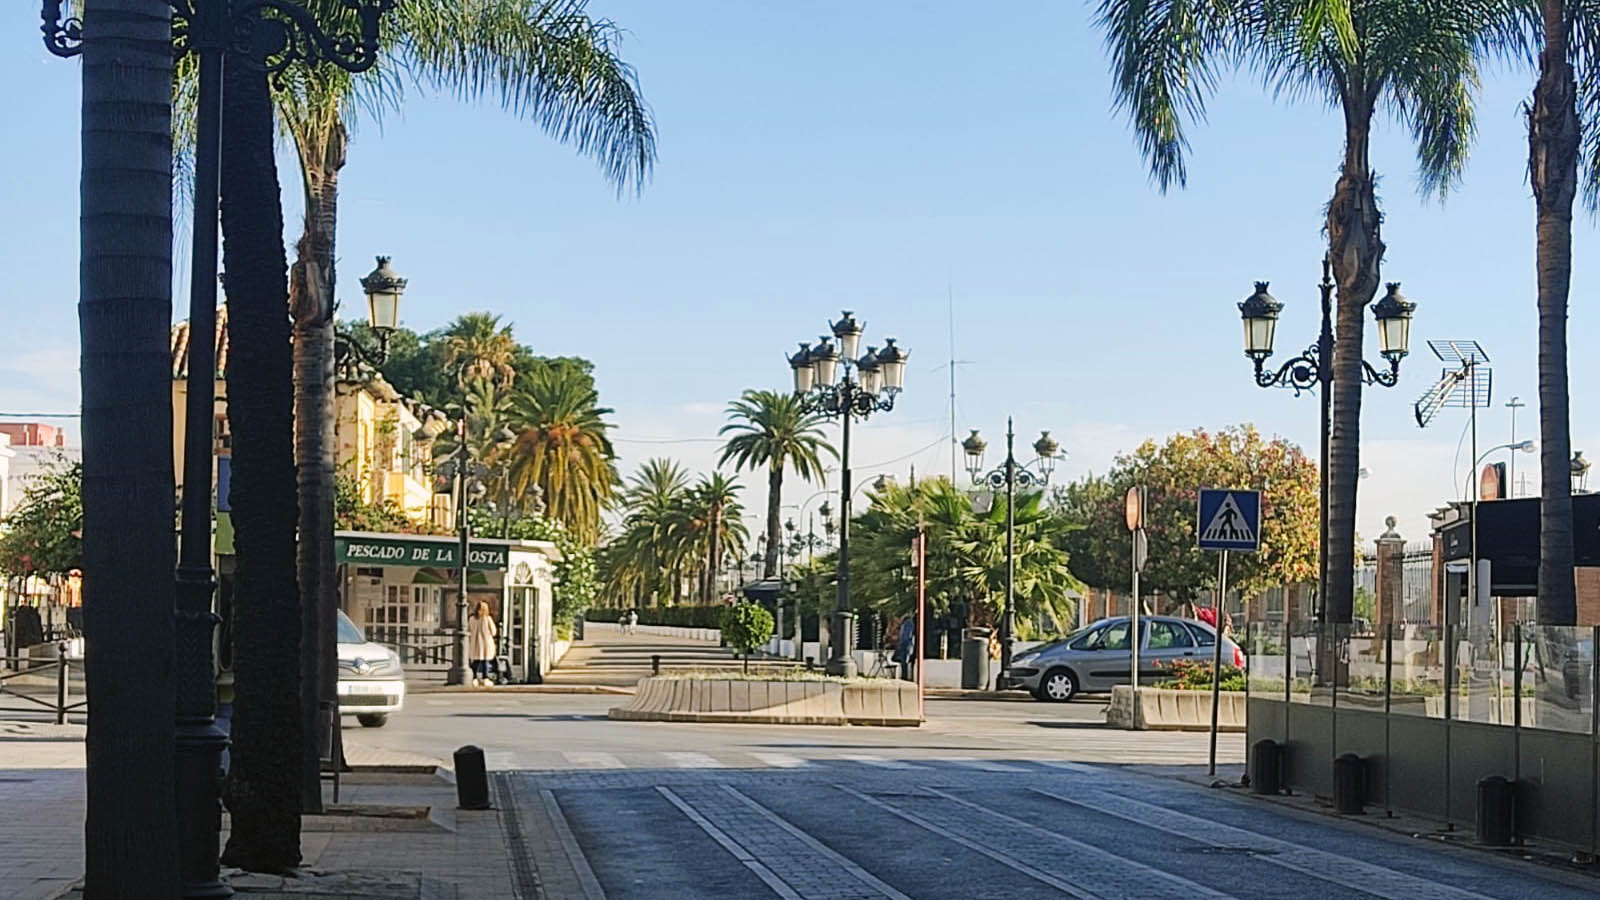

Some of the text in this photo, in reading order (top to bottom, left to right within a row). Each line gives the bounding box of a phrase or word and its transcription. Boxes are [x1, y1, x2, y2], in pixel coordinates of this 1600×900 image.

[347, 544, 505, 564] PESCADO DE LA OSTA
